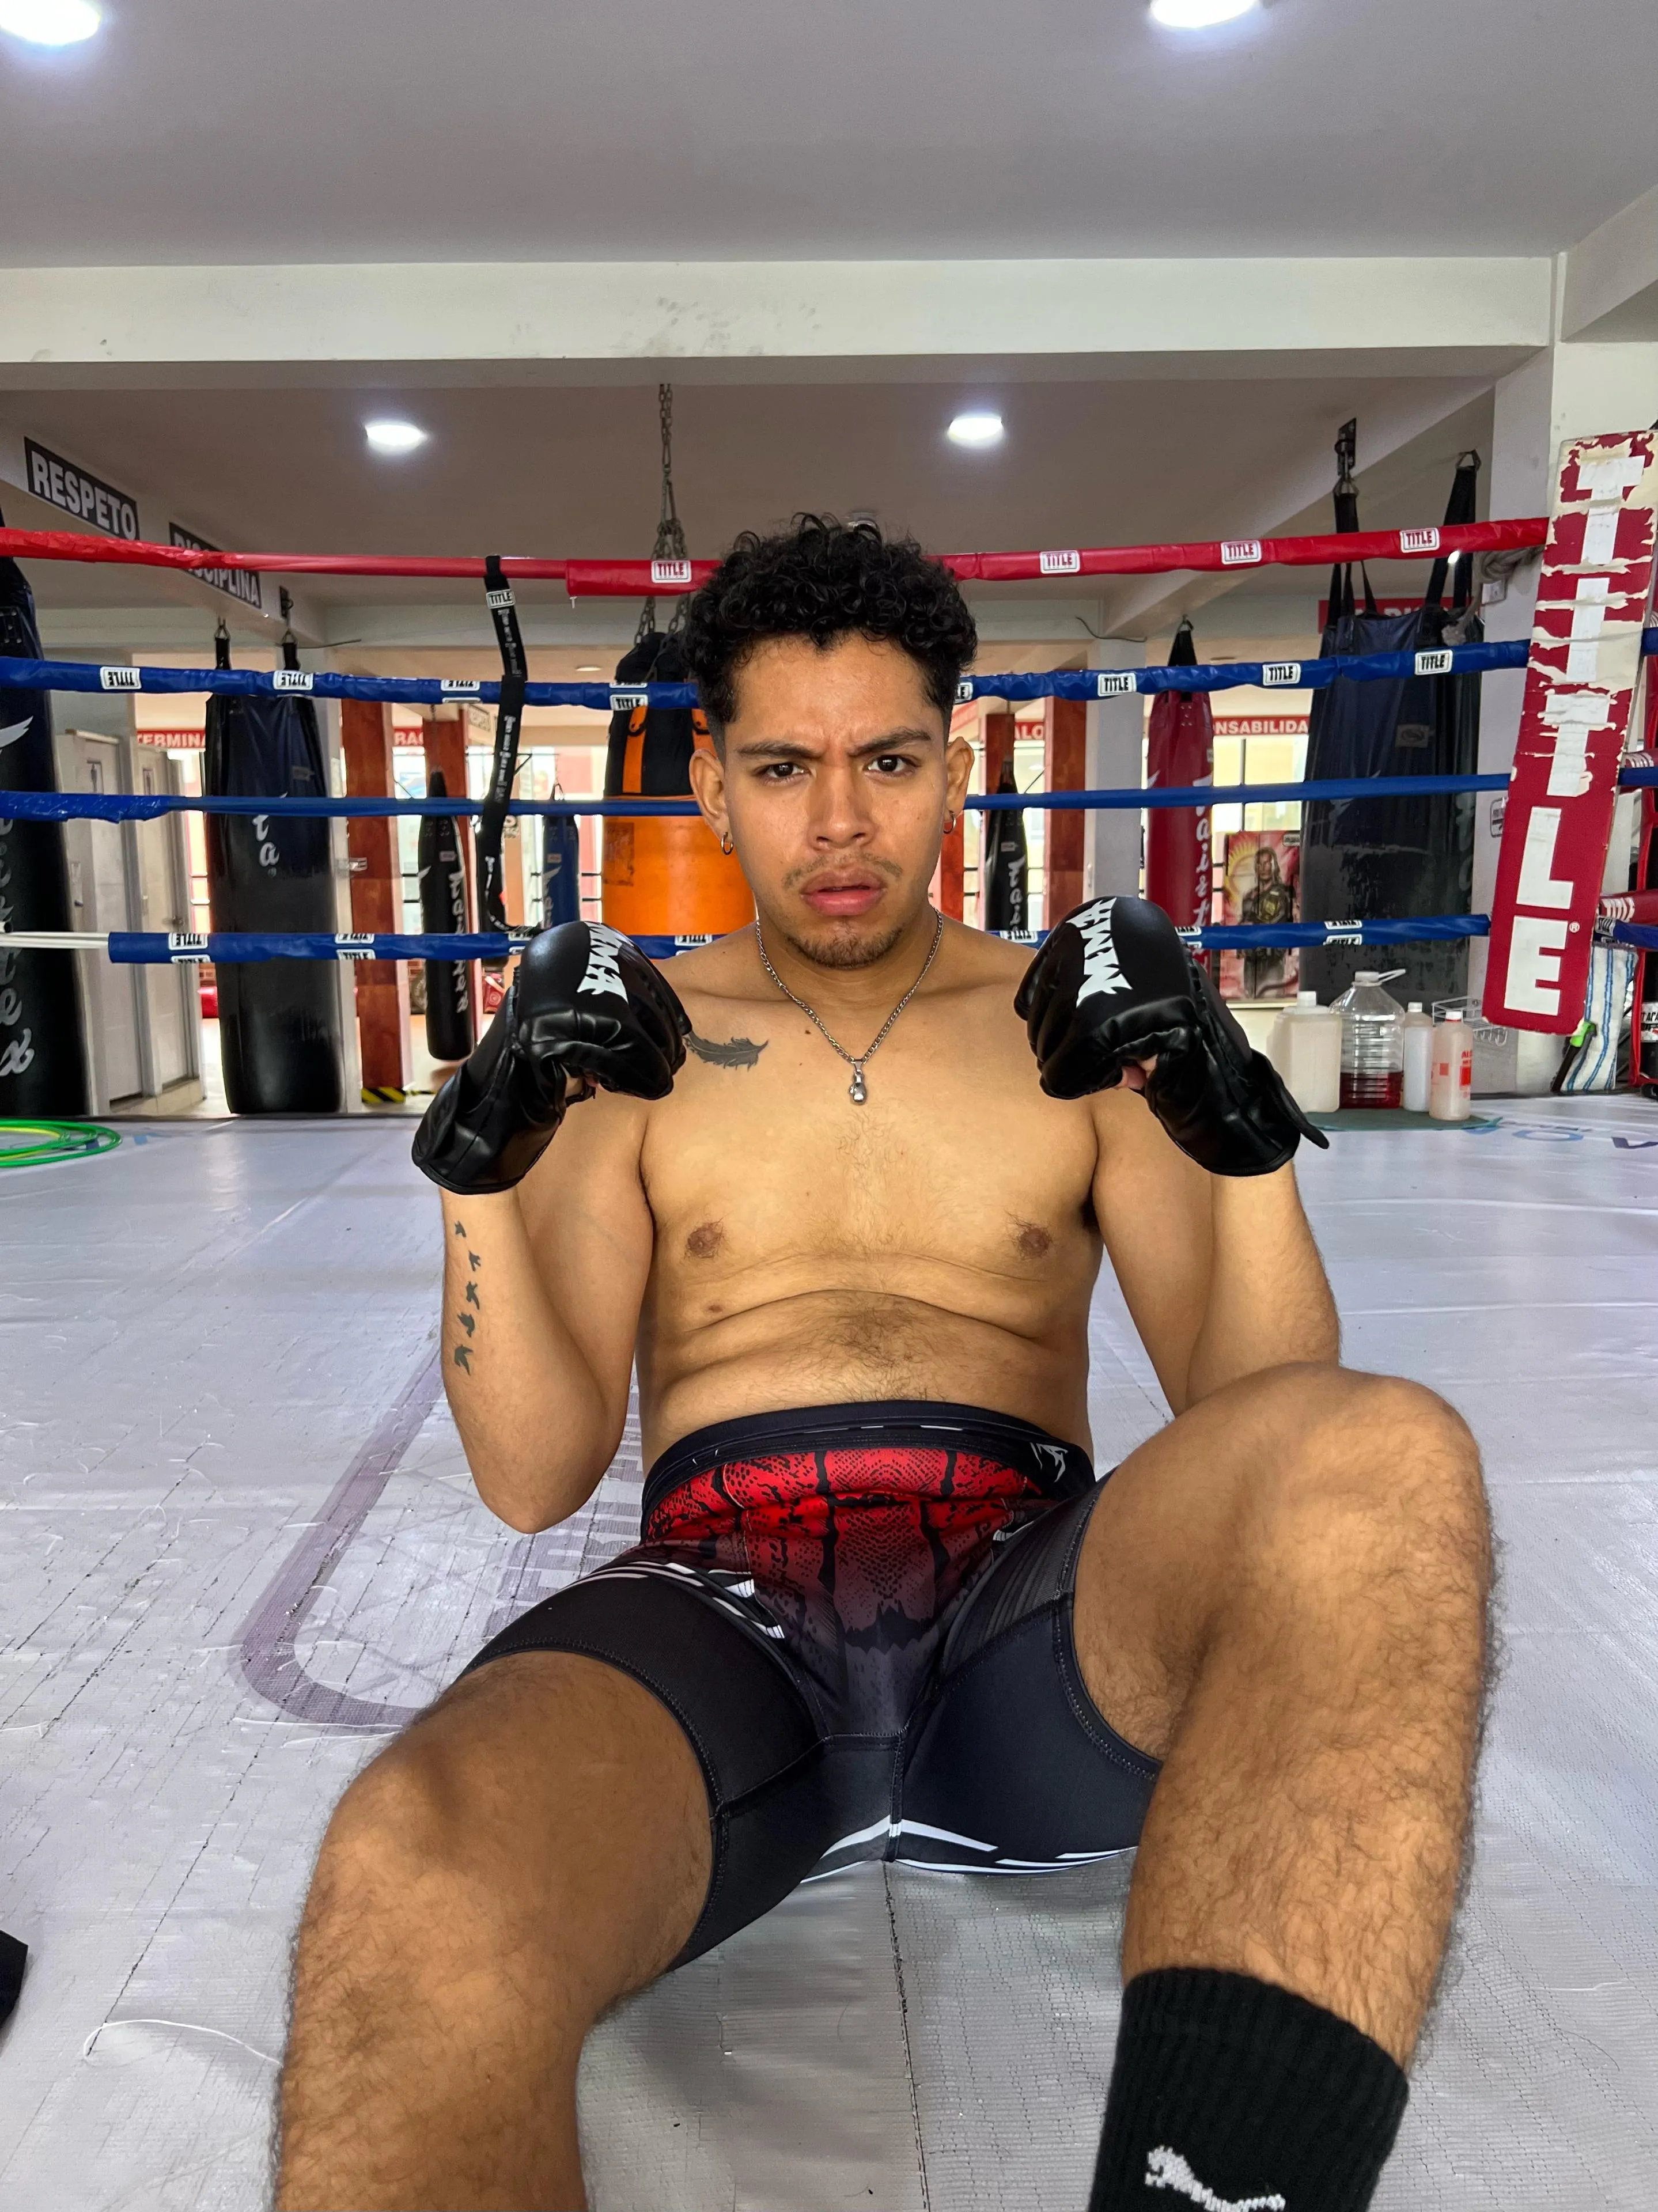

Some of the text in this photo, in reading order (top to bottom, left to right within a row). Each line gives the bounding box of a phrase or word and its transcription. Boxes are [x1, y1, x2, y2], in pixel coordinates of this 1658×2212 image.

[32, 450, 136, 540] RESPETO
[1406, 531, 1432, 544] TITLE
[1228, 543, 1254, 557] TITLE
[1047, 554, 1072, 566] TITLE
[658, 563, 684, 575] TITLE
[490, 592, 511, 604] TITLE
[1421, 656, 1445, 670] TITLE
[108, 672, 135, 685] TITLE
[281, 673, 306, 686] TITLE
[1269, 667, 1293, 681] TITLE
[1104, 677, 1129, 691] TITLE
[1213, 721, 1308, 734] NSABILIDA
[137, 732, 206, 748] TERMIN
[1504, 455, 1645, 1016] TITLE
